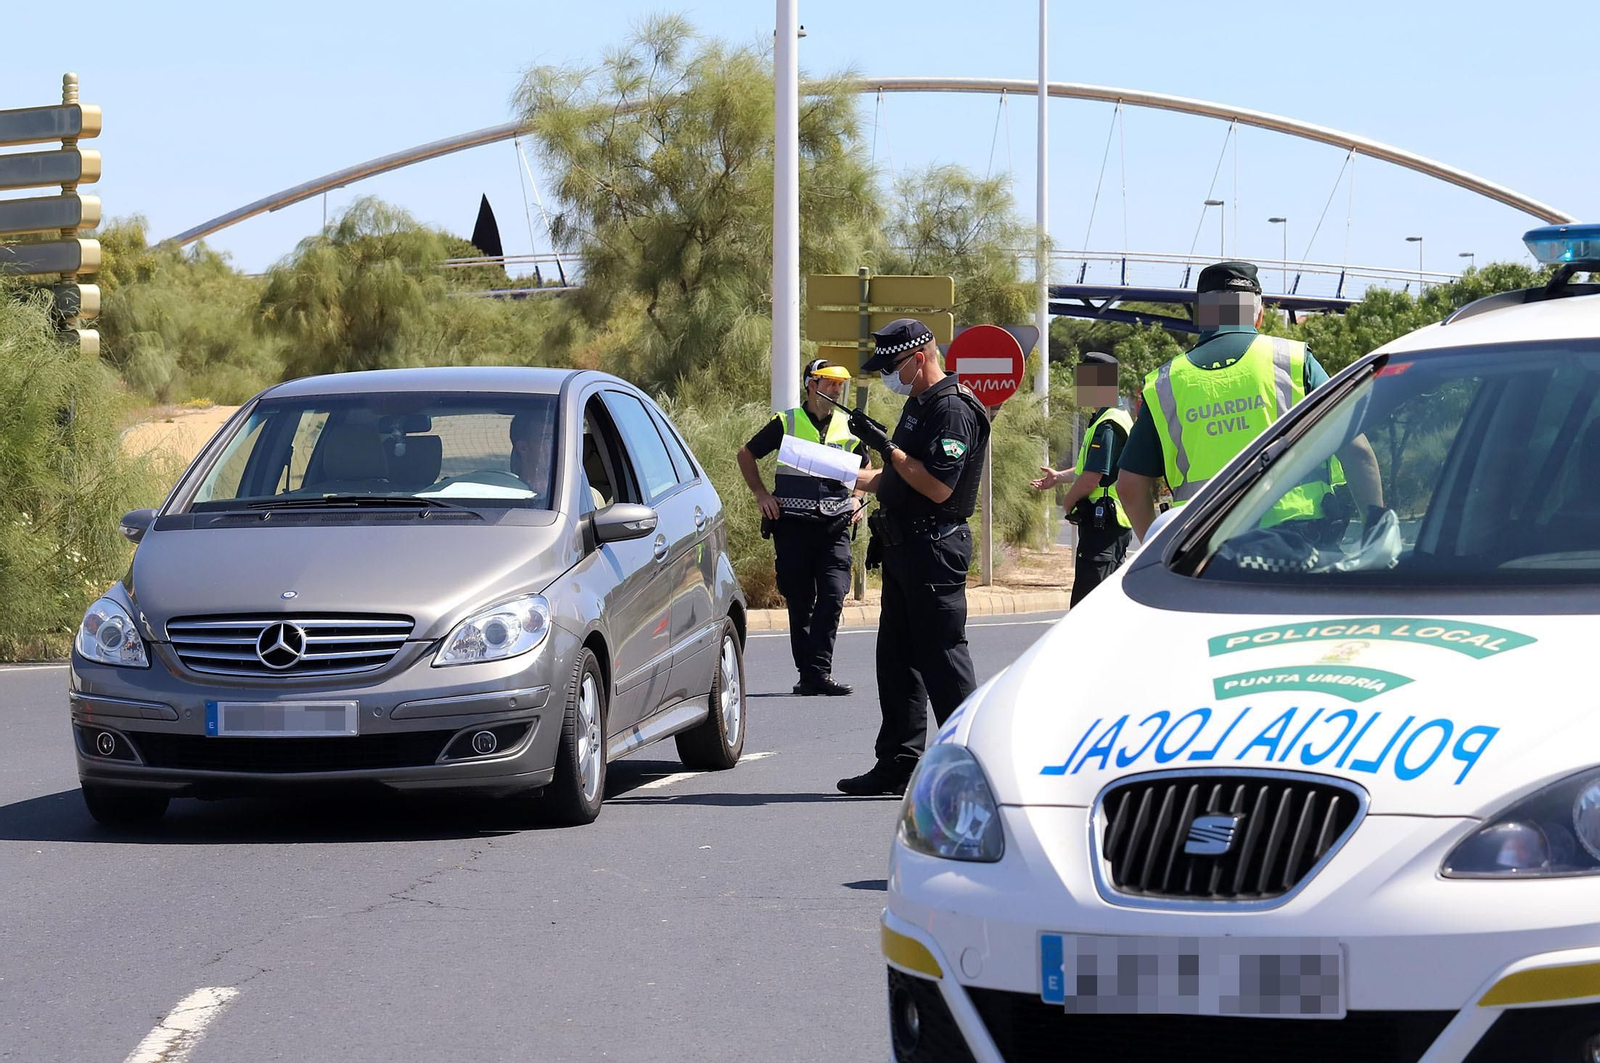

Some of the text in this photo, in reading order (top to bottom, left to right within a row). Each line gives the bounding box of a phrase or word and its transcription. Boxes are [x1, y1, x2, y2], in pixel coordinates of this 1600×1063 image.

[1186, 395, 1266, 423] GUARDIA
[1206, 417, 1250, 436] CIVIL
[1225, 623, 1508, 652] POLICIA LOCAL
[1223, 674, 1300, 690] PUNTA
[1048, 976, 1058, 990] E
